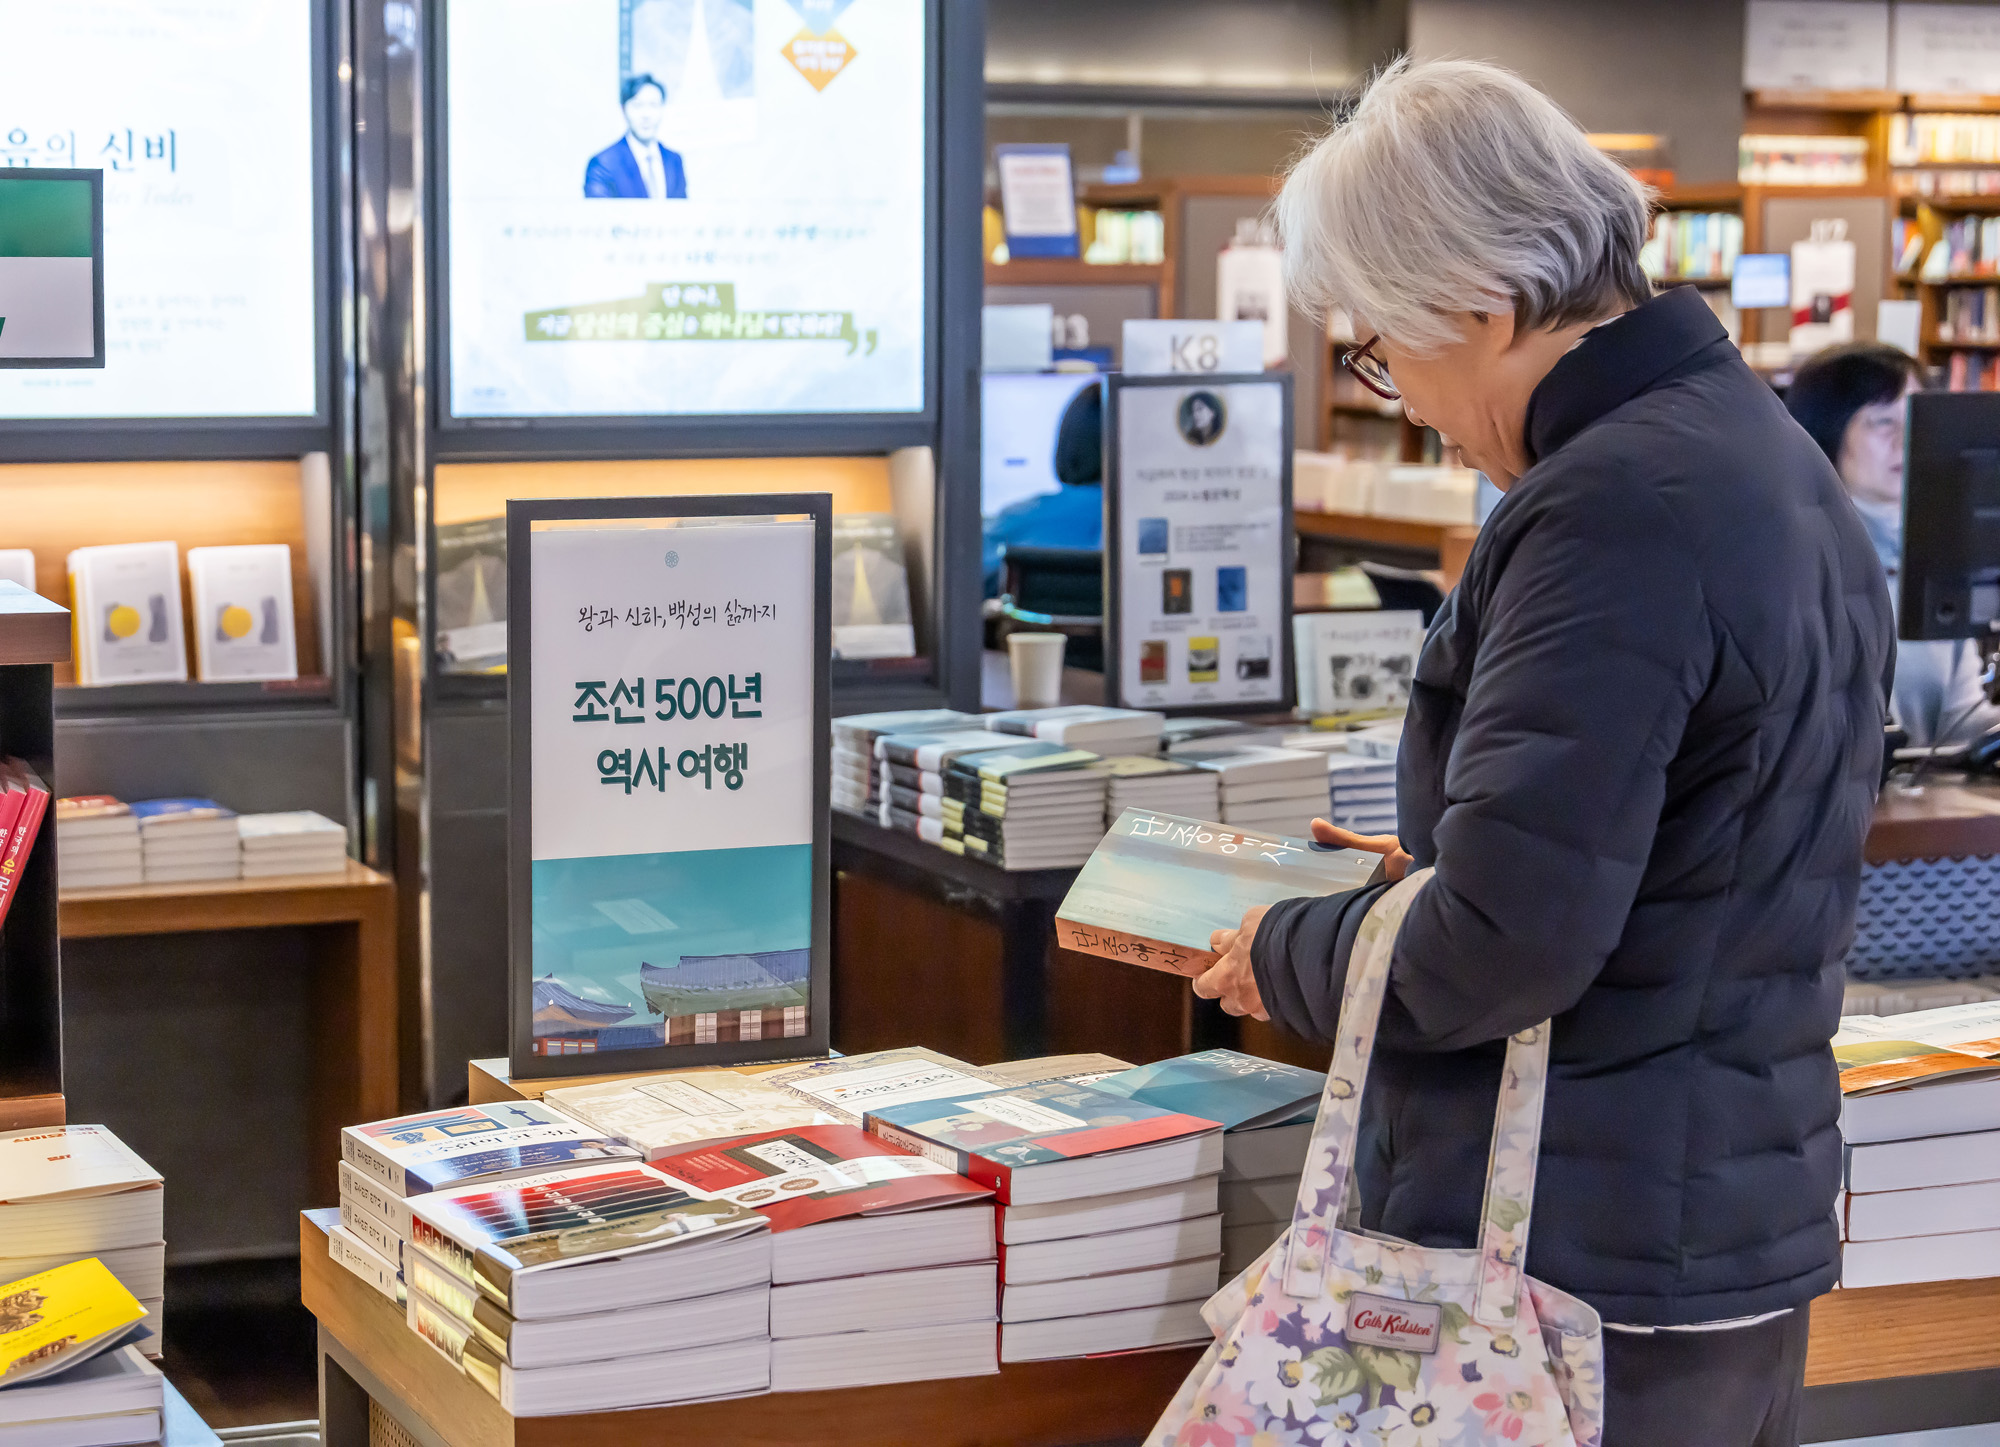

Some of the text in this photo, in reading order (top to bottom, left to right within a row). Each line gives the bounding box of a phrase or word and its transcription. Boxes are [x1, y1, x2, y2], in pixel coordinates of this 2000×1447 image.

[100, 127, 176, 173] 신비
[1171, 334, 1219, 373] K8
[578, 606, 619, 632] 왕과
[724, 598, 777, 627] 삶까지
[572, 672, 763, 725] 조선 500년
[597, 742, 749, 795] 역사 여행
[11, 826, 26, 856] 한국의
[1129, 815, 1305, 867] 단종애사
[1071, 927, 1188, 971] 단종애사
[1354, 1310, 1431, 1336] Cath Kidston
[1377, 1334, 1406, 1343] LONDON
